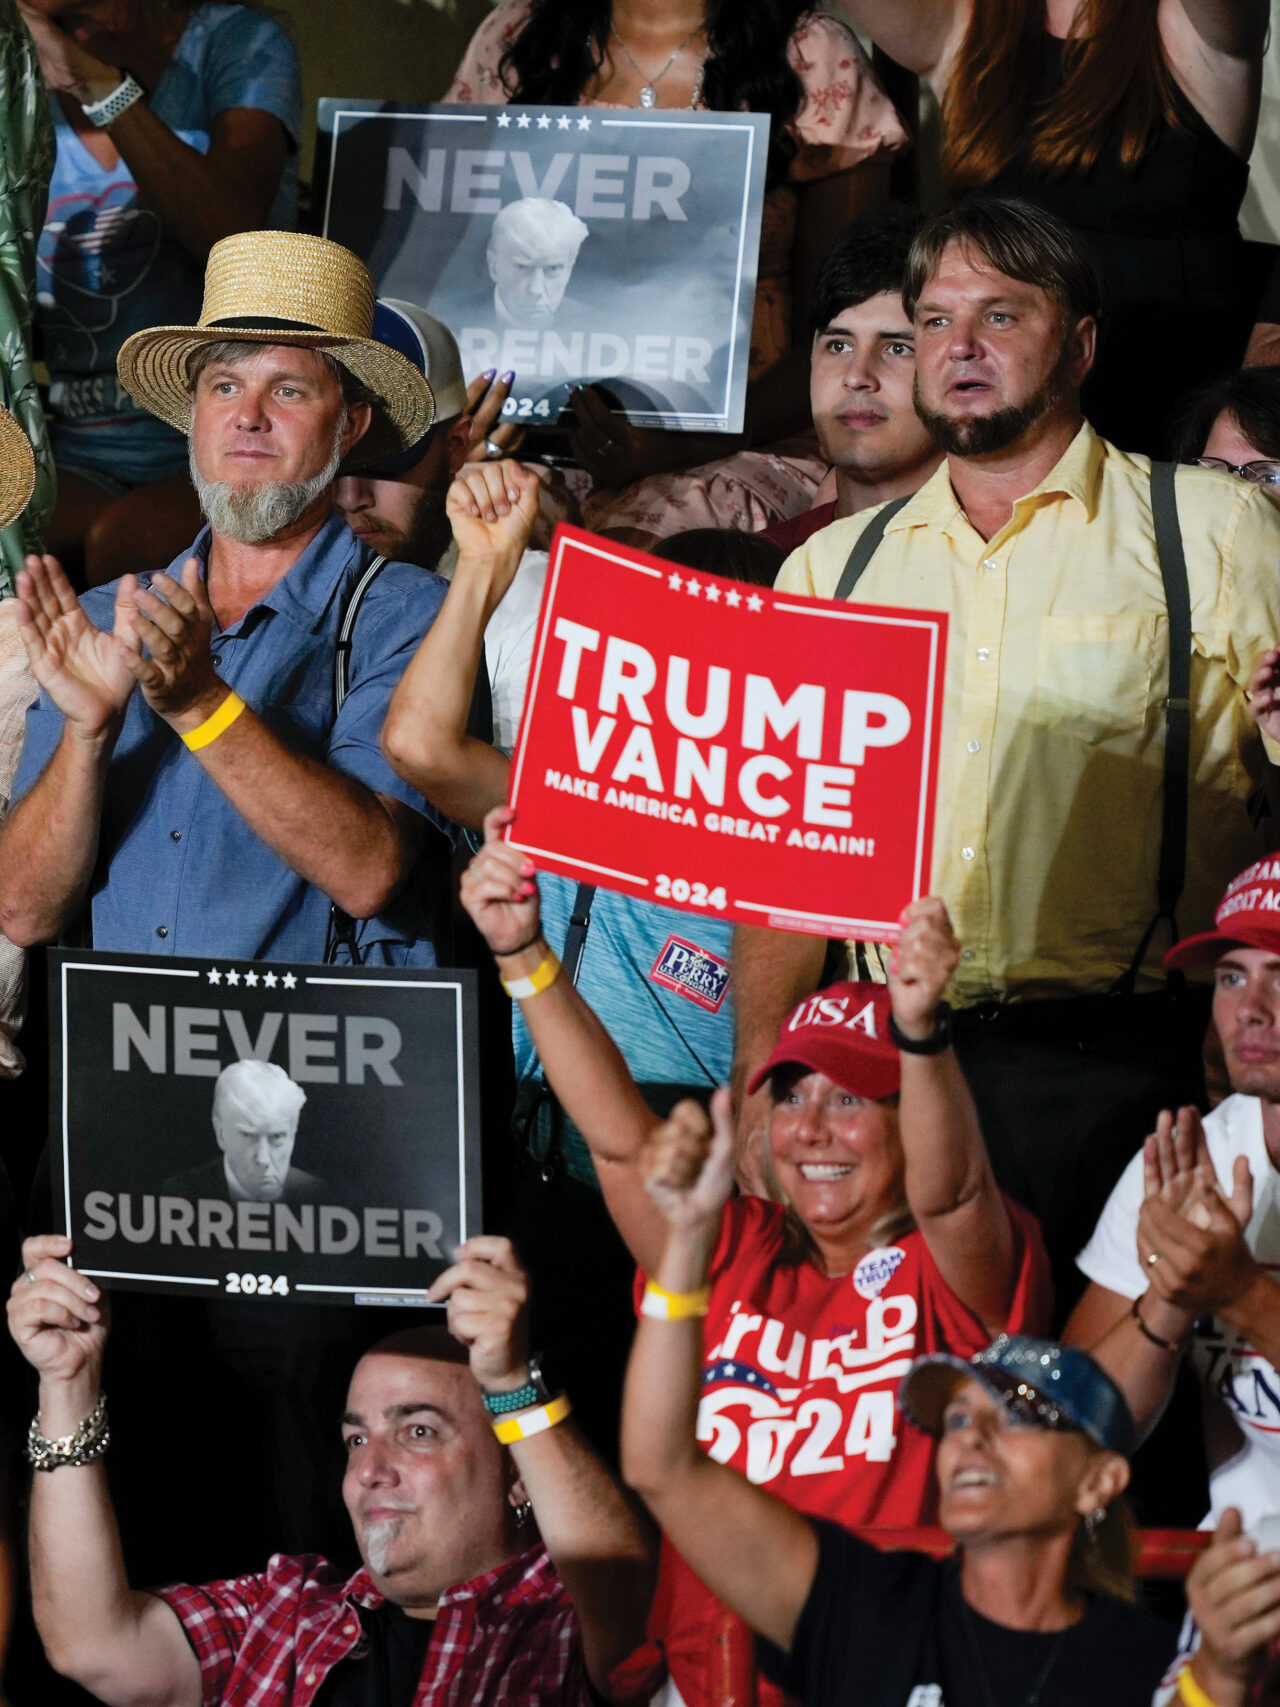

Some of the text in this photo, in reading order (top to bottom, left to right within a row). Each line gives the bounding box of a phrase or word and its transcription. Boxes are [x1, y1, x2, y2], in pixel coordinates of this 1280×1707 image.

[383, 147, 692, 221] NEVER
[459, 327, 714, 384] RENDER
[501, 397, 550, 417] 024
[554, 617, 911, 766] TRUMP
[571, 705, 856, 828] VANCE
[545, 769, 875, 857] MAKE AMERICA GREAT AGAIN!
[654, 874, 727, 910] 2024
[665, 945, 723, 991] PERRY
[112, 1002, 404, 1087] NEVER
[789, 996, 879, 1040] USA
[83, 1191, 444, 1259] SURRENDER
[225, 1272, 289, 1296] 2024
